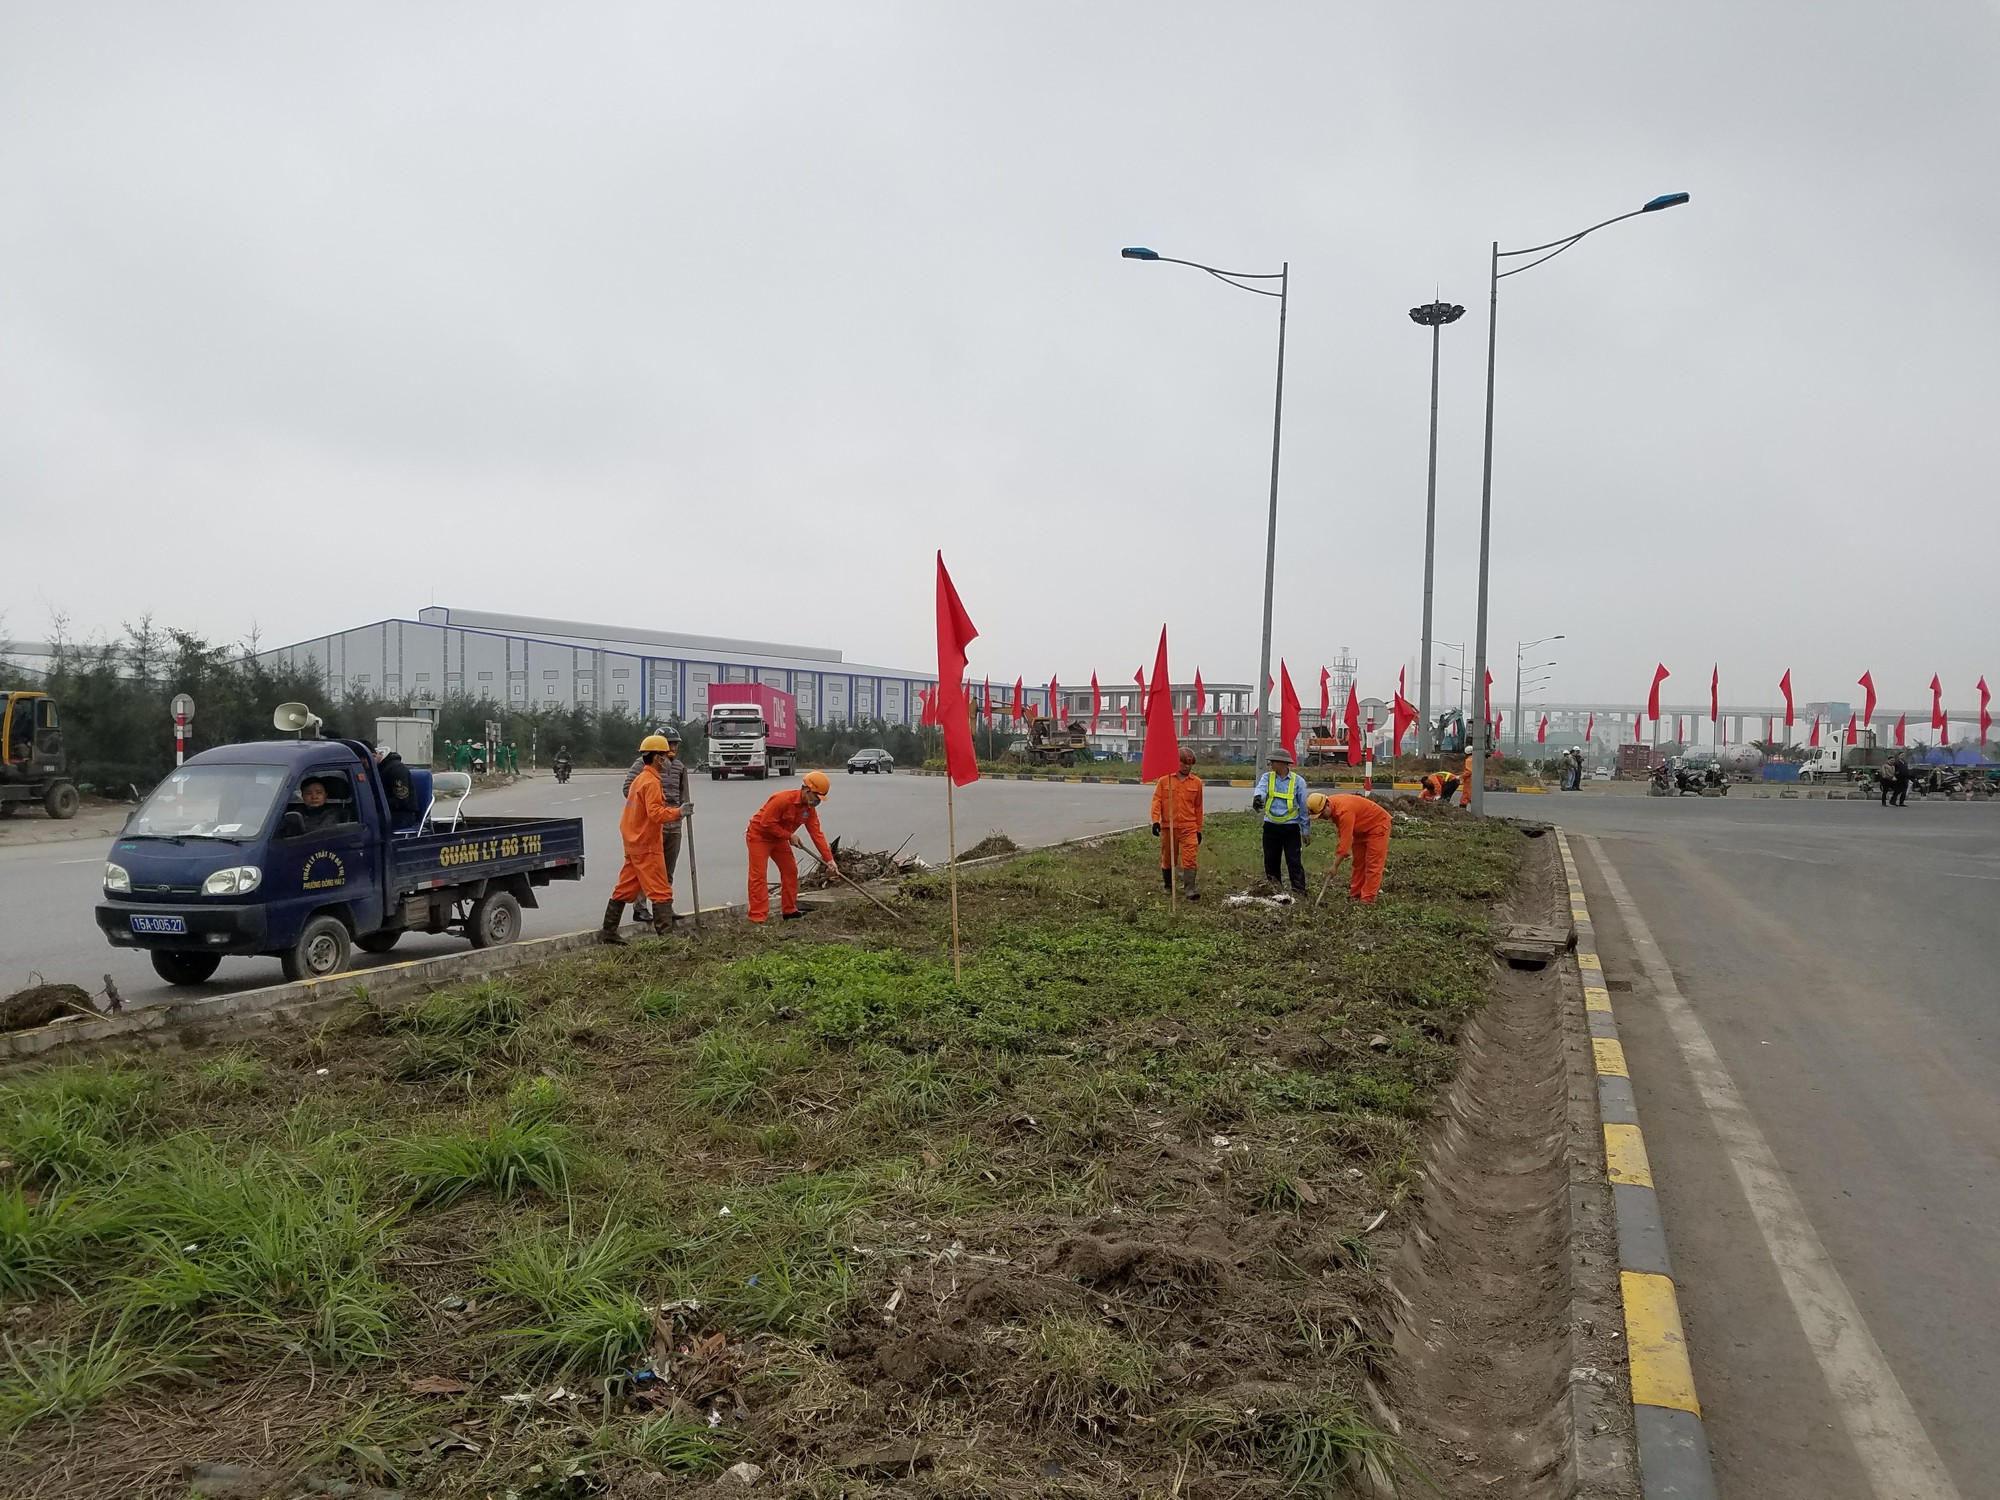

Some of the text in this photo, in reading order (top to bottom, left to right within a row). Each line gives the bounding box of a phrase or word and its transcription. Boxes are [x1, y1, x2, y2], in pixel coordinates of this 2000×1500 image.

[440, 838, 479, 867] QUẢN
[482, 837, 499, 860] LÝ
[521, 834, 542, 856] THỊ
[134, 918, 182, 931] 15A-005.27
